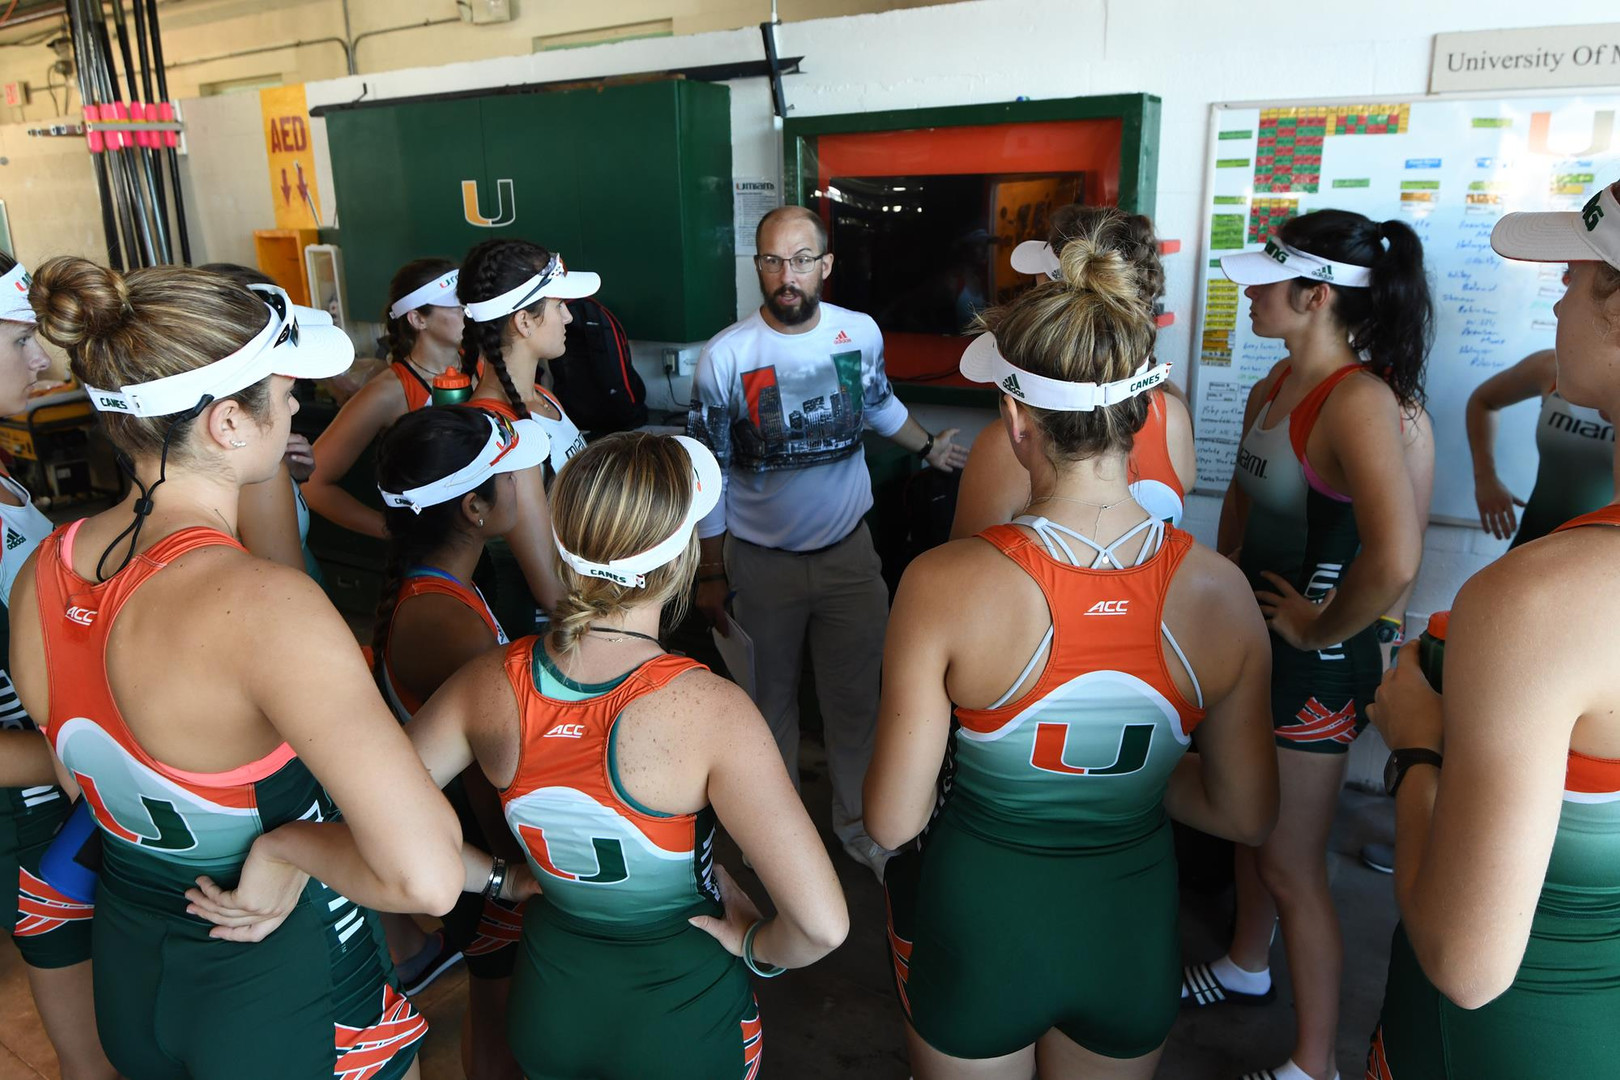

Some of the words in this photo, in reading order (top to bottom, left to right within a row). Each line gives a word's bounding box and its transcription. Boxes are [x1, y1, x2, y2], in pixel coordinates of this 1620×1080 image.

[1447, 47, 1564, 73] University
[1572, 44, 1607, 67] Of
[270, 116, 308, 154] AED
[461, 178, 516, 228] U
[1130, 372, 1161, 393] CANES
[99, 397, 128, 410] CANES
[589, 567, 627, 584] CANES
[66, 605, 98, 625] ACC
[1085, 599, 1130, 614] ACC
[545, 723, 586, 737] ACC
[1030, 721, 1158, 777] U
[73, 769, 198, 852] U
[517, 823, 630, 884] U
